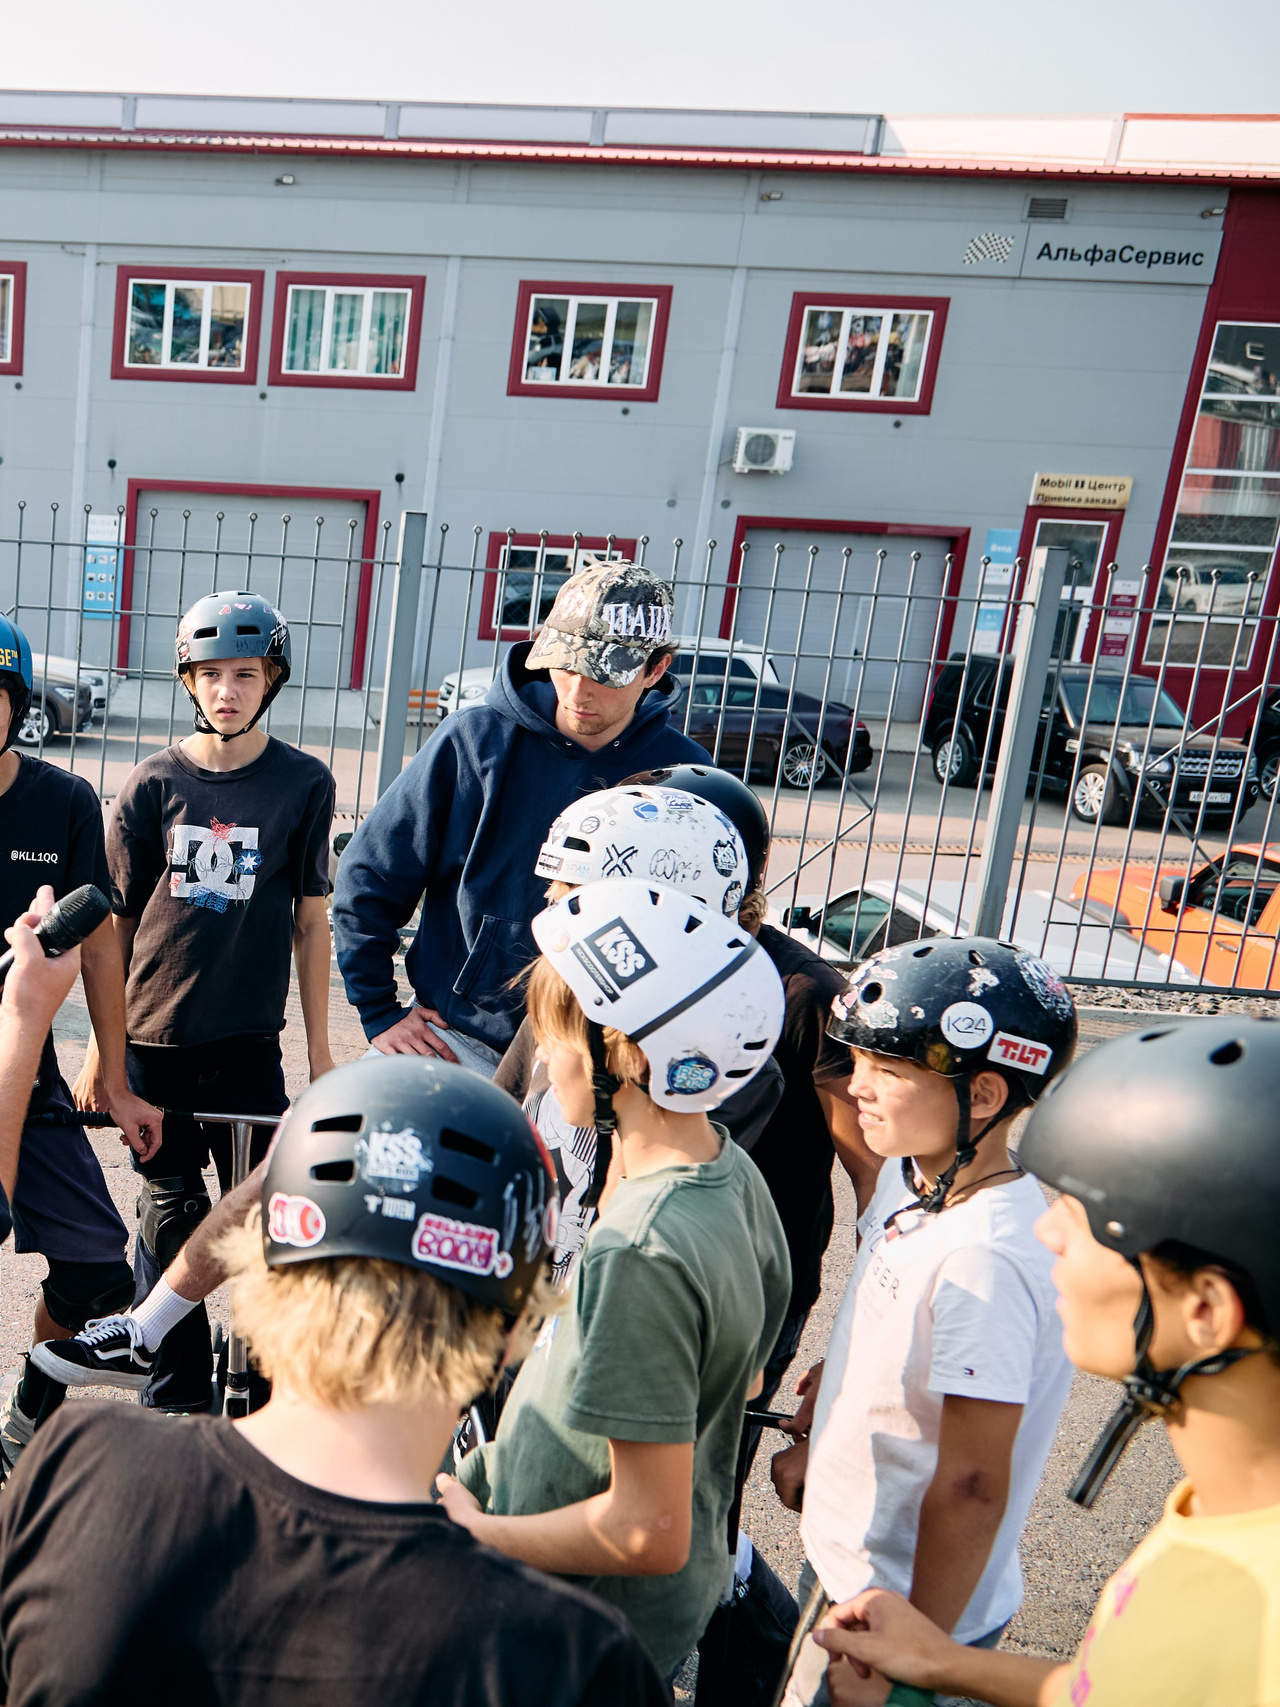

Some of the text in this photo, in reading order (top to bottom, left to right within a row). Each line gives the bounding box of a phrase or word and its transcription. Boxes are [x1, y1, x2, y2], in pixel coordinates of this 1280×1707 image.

[1036, 243, 1205, 269] АльфаСервис
[1040, 478, 1071, 488] Mobil
[1088, 480, 1126, 493] Центр
[1036, 493, 1117, 505] Приемка заказа
[10, 849, 59, 865] @KLL1QQ
[594, 925, 646, 978] KSS
[947, 1015, 988, 1035] K24
[677, 1064, 714, 1080] RSC
[369, 1130, 423, 1167] KSS
